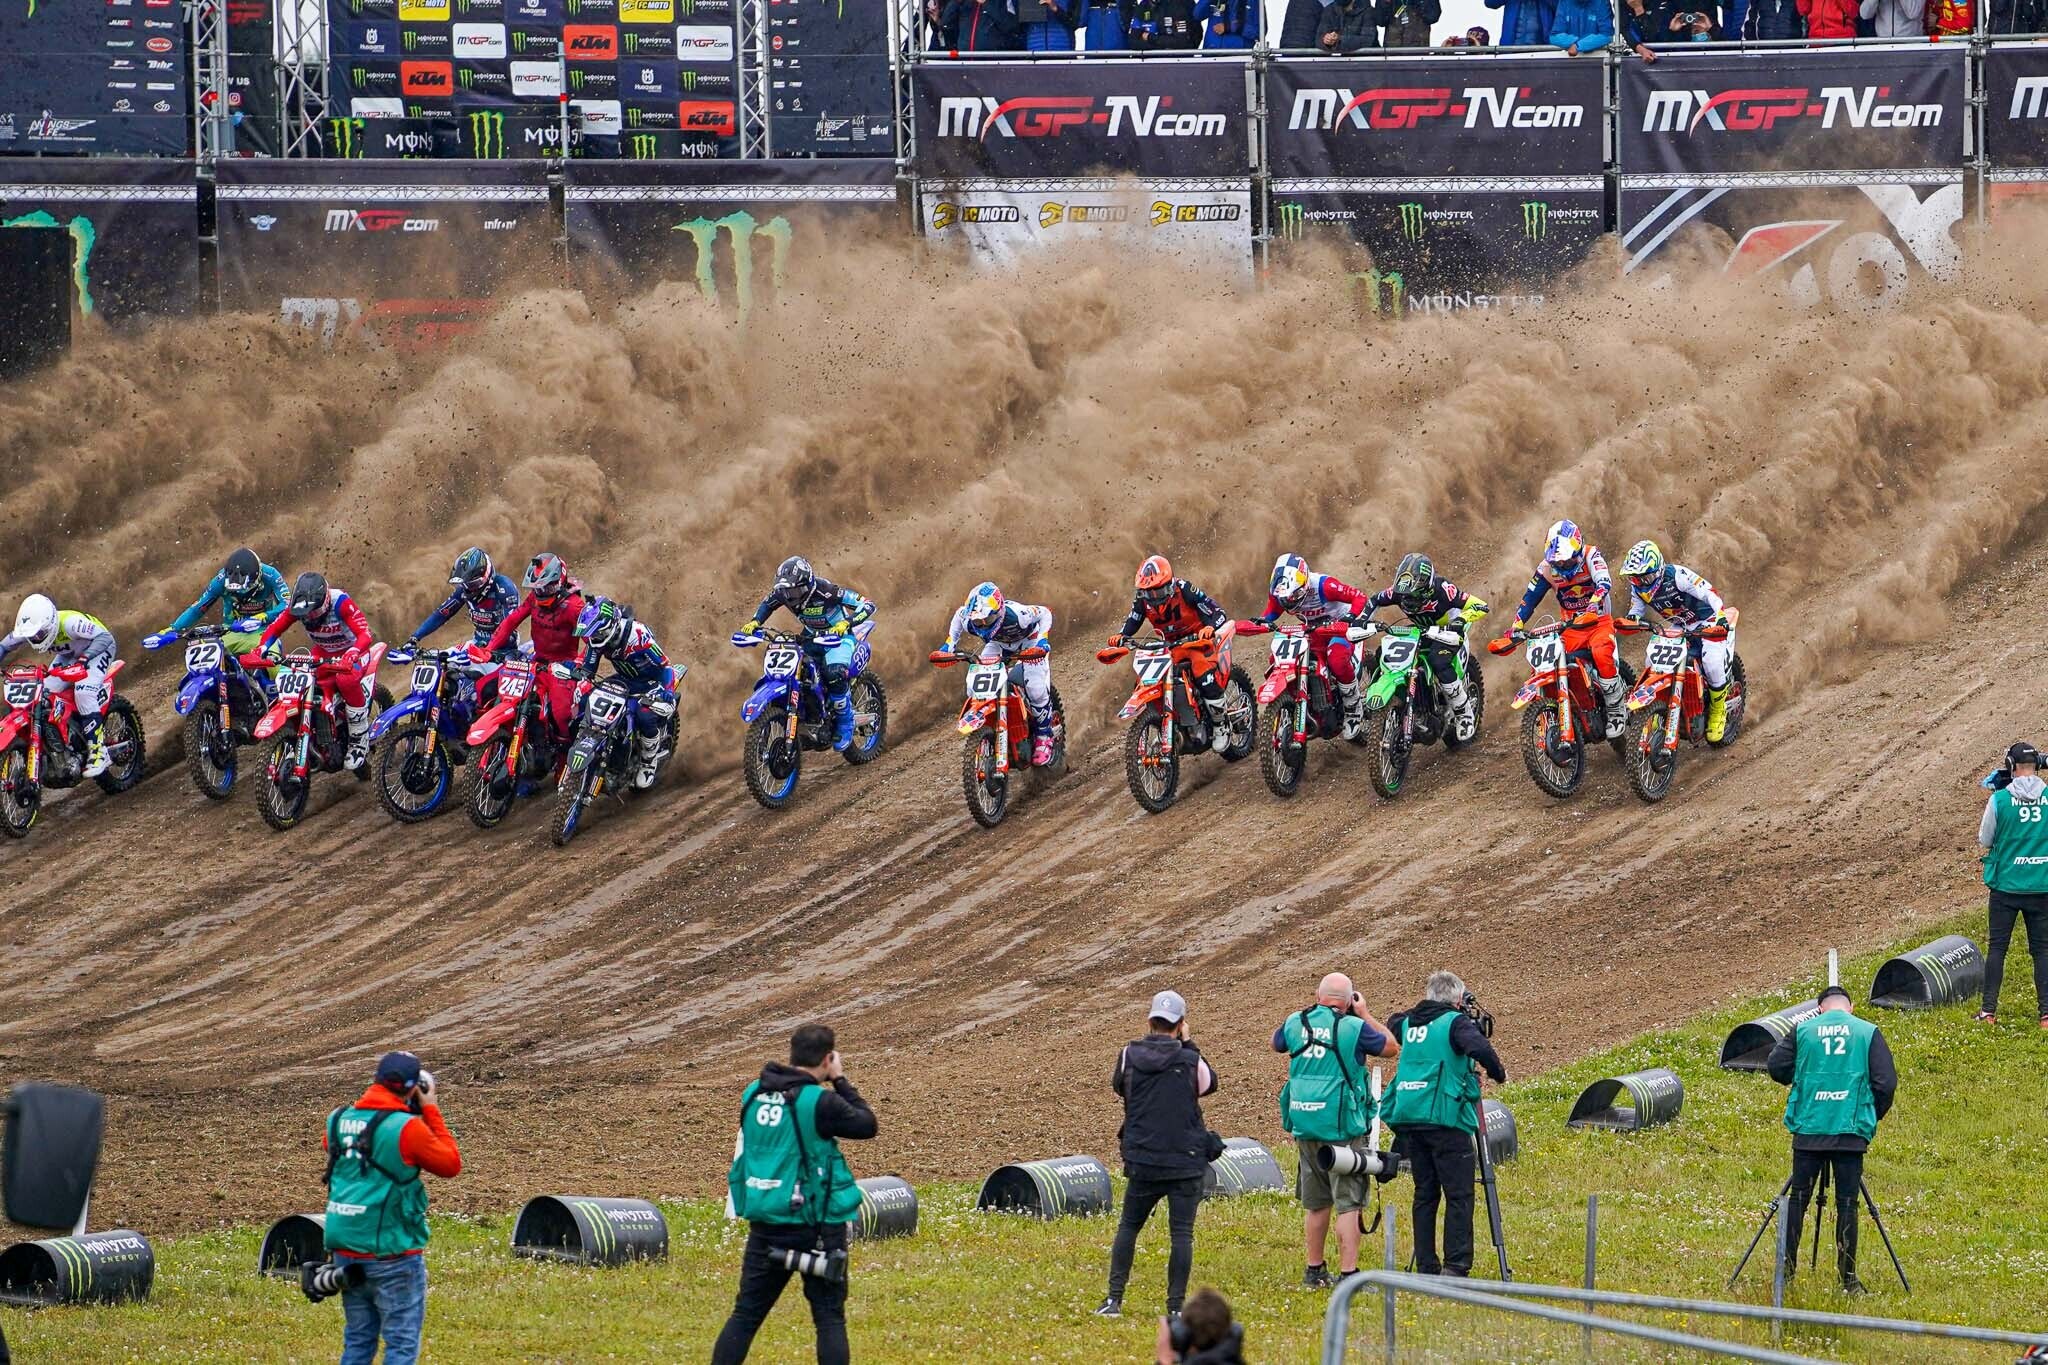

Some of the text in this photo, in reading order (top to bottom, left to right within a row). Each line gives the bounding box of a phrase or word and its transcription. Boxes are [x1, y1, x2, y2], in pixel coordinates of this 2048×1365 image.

[571, 35, 611, 50] KTM
[408, 72, 447, 85] KTM
[687, 110, 728, 126] KTM
[1304, 210, 1356, 220] MONSTER
[1423, 210, 1474, 220] MONSTER
[1547, 209, 1599, 219] MONSTER
[189, 644, 218, 665] 22
[1276, 639, 1303, 660] 41
[1384, 641, 1415, 663] 3
[1531, 643, 1556, 668] 84
[1650, 644, 1683, 666] 222
[767, 651, 795, 669] 32
[1137, 657, 1172, 679] 77
[279, 674, 309, 694] 189
[415, 667, 435, 685] 10
[972, 673, 1001, 693] 61
[7, 684, 38, 704] 29
[498, 677, 529, 697] 243
[592, 697, 623, 721] 91
[2019, 806, 2042, 823] 93
[1938, 944, 1975, 965] MONSTER
[1406, 1026, 1428, 1043] 09
[1817, 1025, 1850, 1037] IMPA
[1821, 1037, 1846, 1056] 12
[756, 1104, 783, 1127] 69
[339, 1119, 368, 1134] IMP
[1223, 1146, 1268, 1160] MONSTER
[1053, 1162, 1101, 1178] MONSTER
[868, 1186, 911, 1202] MONSTER
[604, 1208, 659, 1223] MONSTER
[81, 1236, 145, 1256] MONSTER
[101, 1253, 140, 1264] ENERGY
